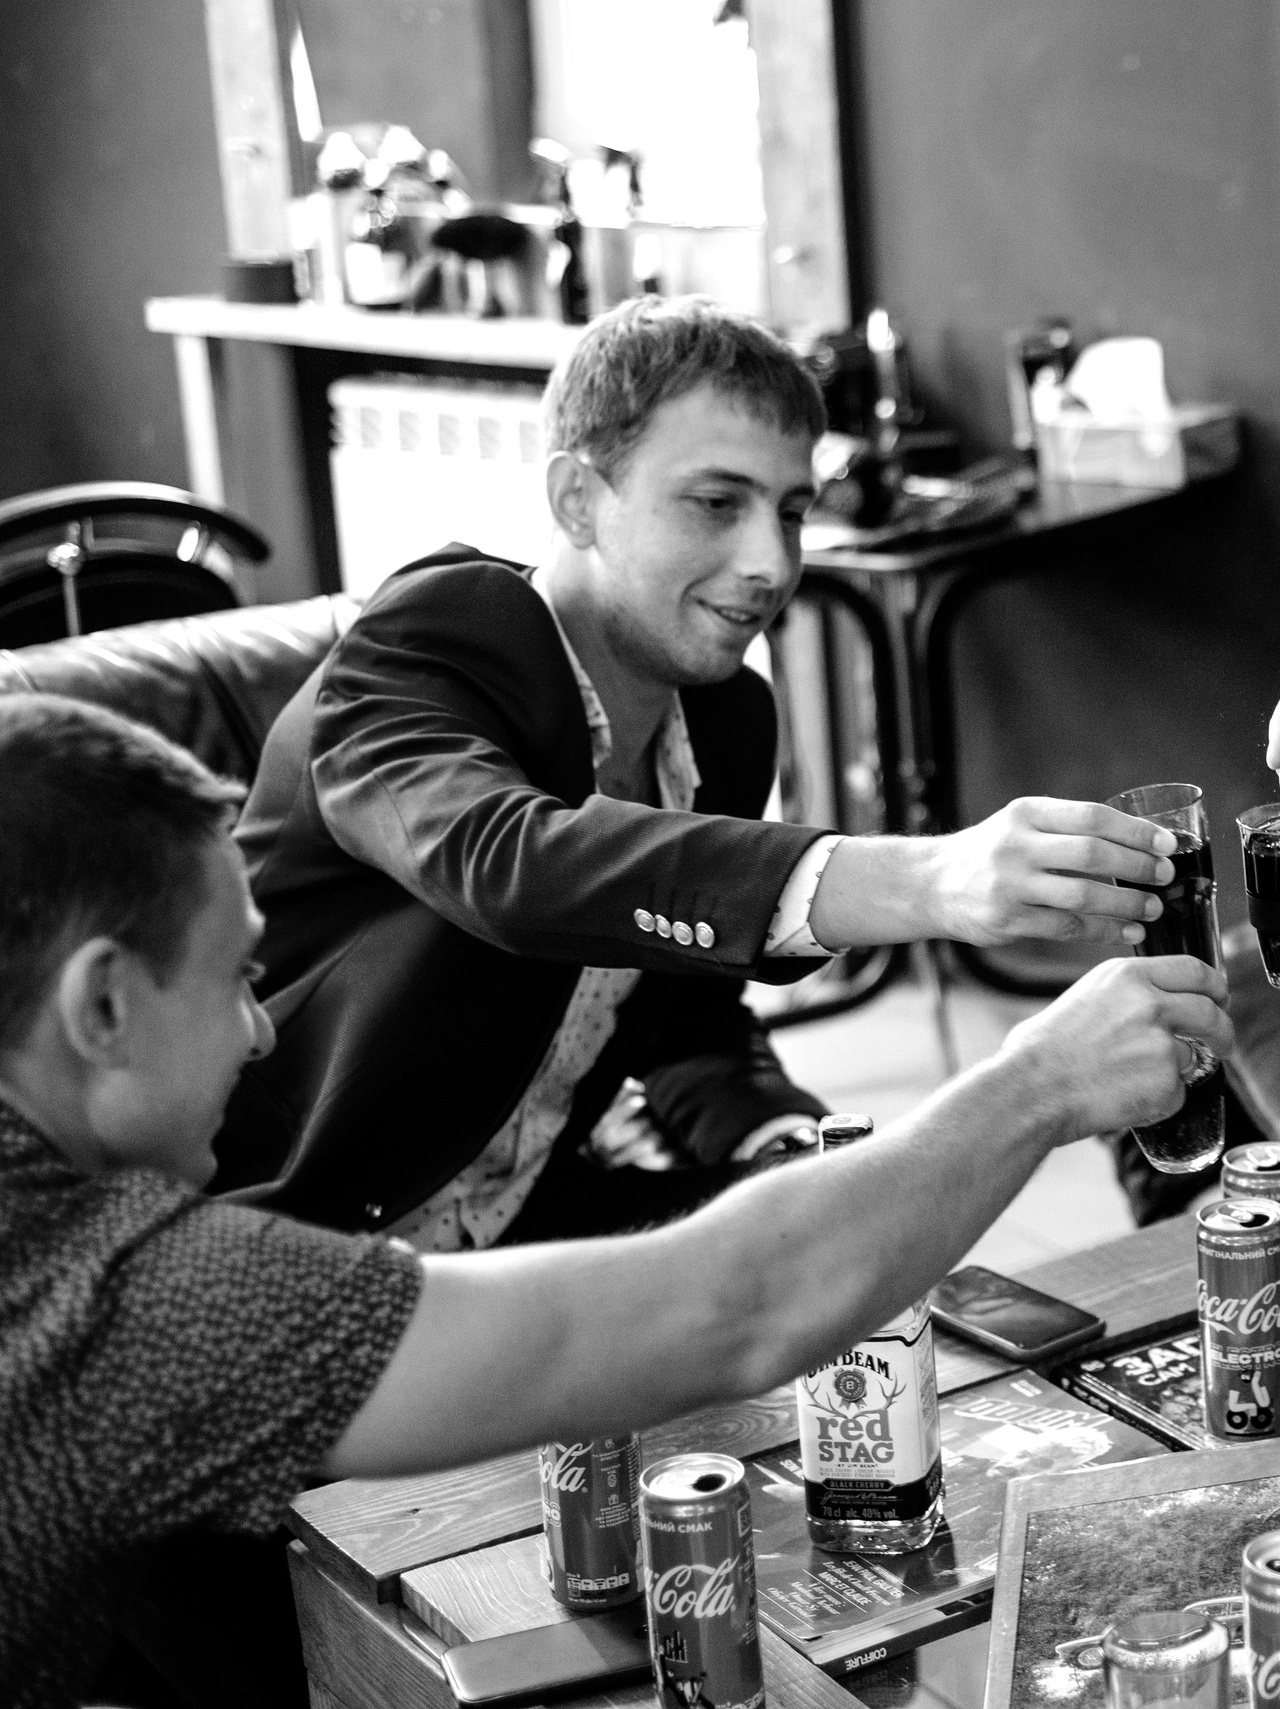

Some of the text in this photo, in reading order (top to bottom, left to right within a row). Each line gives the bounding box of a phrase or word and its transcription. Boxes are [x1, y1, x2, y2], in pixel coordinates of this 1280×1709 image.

[816, 1410, 893, 1441] red
[818, 1441, 894, 1463] STAG
[539, 1442, 594, 1492] ola
[829, 1480, 853, 1488] BLACK
[822, 1506, 899, 1519] 70 cl alc. 40% vol.
[678, 1521, 713, 1533] СМАК
[845, 1647, 887, 1671] COIFFURE
